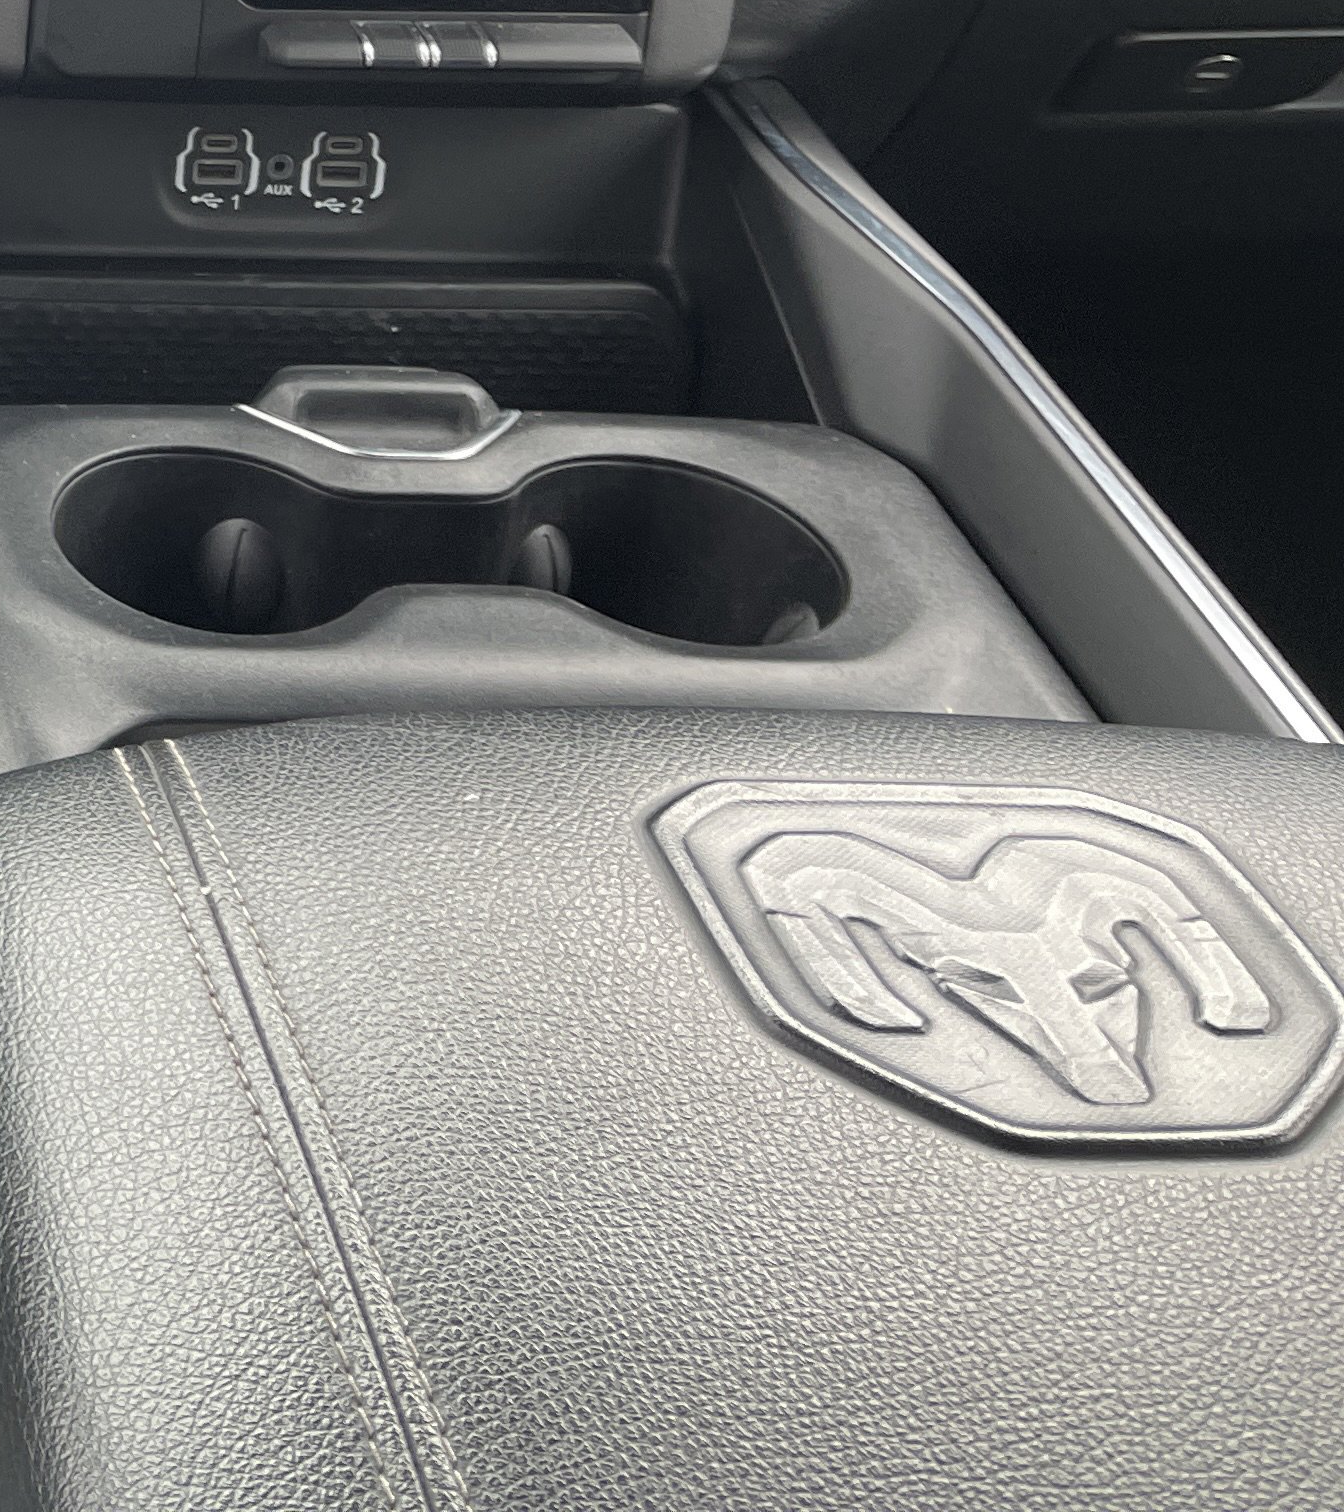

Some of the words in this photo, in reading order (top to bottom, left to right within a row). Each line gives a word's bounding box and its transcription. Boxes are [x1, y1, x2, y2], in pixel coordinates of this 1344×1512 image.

[263, 184, 293, 196] AUX
[231, 194, 240, 210] 1
[350, 197, 364, 214] 2
